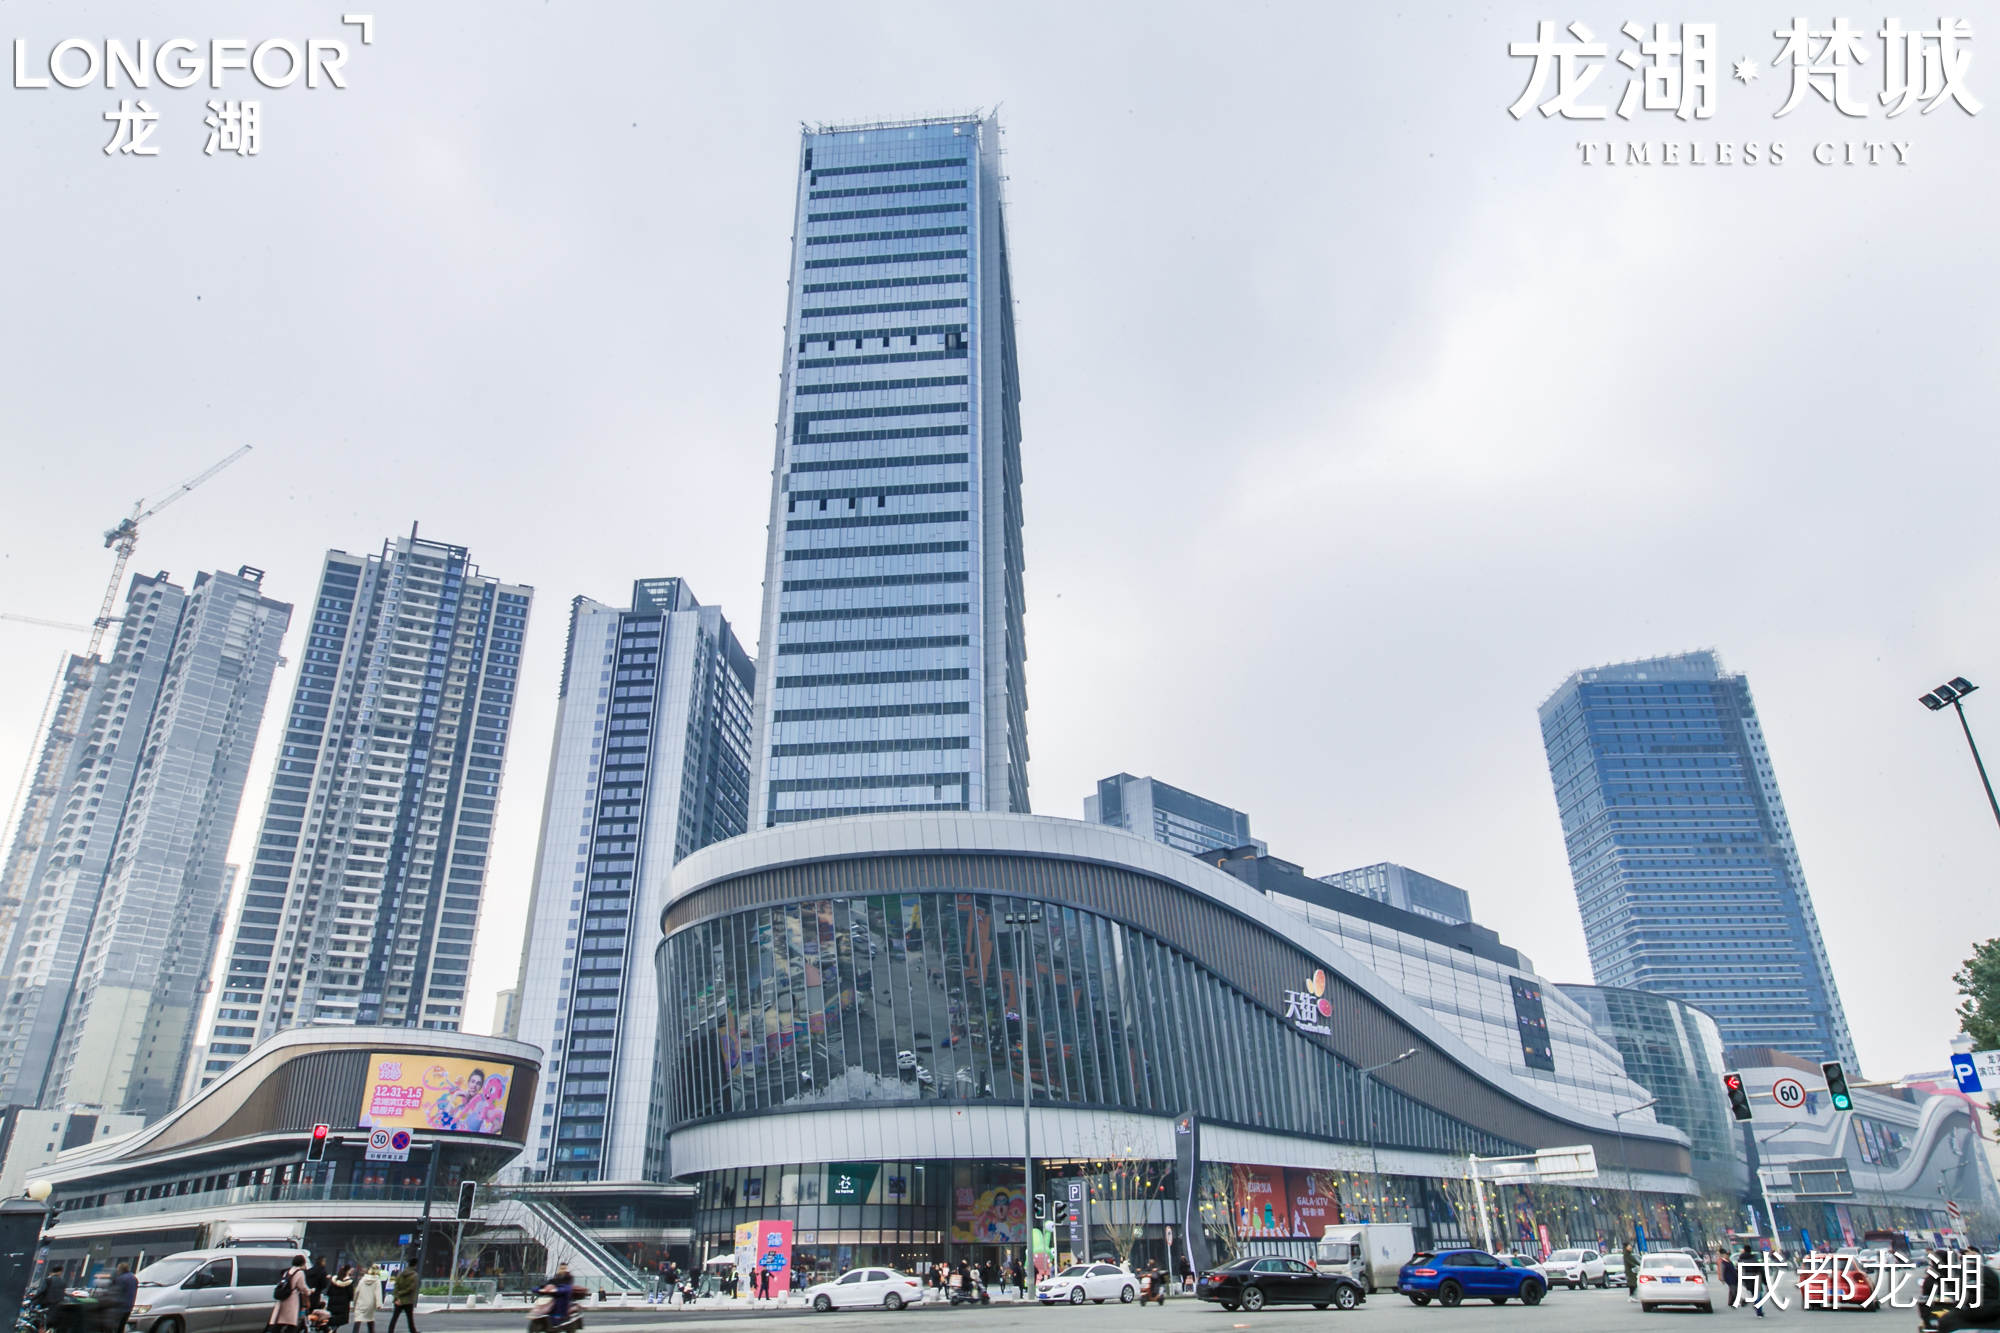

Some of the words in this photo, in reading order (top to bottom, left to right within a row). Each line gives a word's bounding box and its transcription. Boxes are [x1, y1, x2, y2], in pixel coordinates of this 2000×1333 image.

[1284, 989, 1318, 1023] 天街
[1954, 1063, 1974, 1084] P
[375, 1086, 422, 1098] 12.31-1.5
[1780, 1085, 1799, 1102] 60
[374, 1134, 387, 1145] 30
[1071, 1186, 1079, 1199] P
